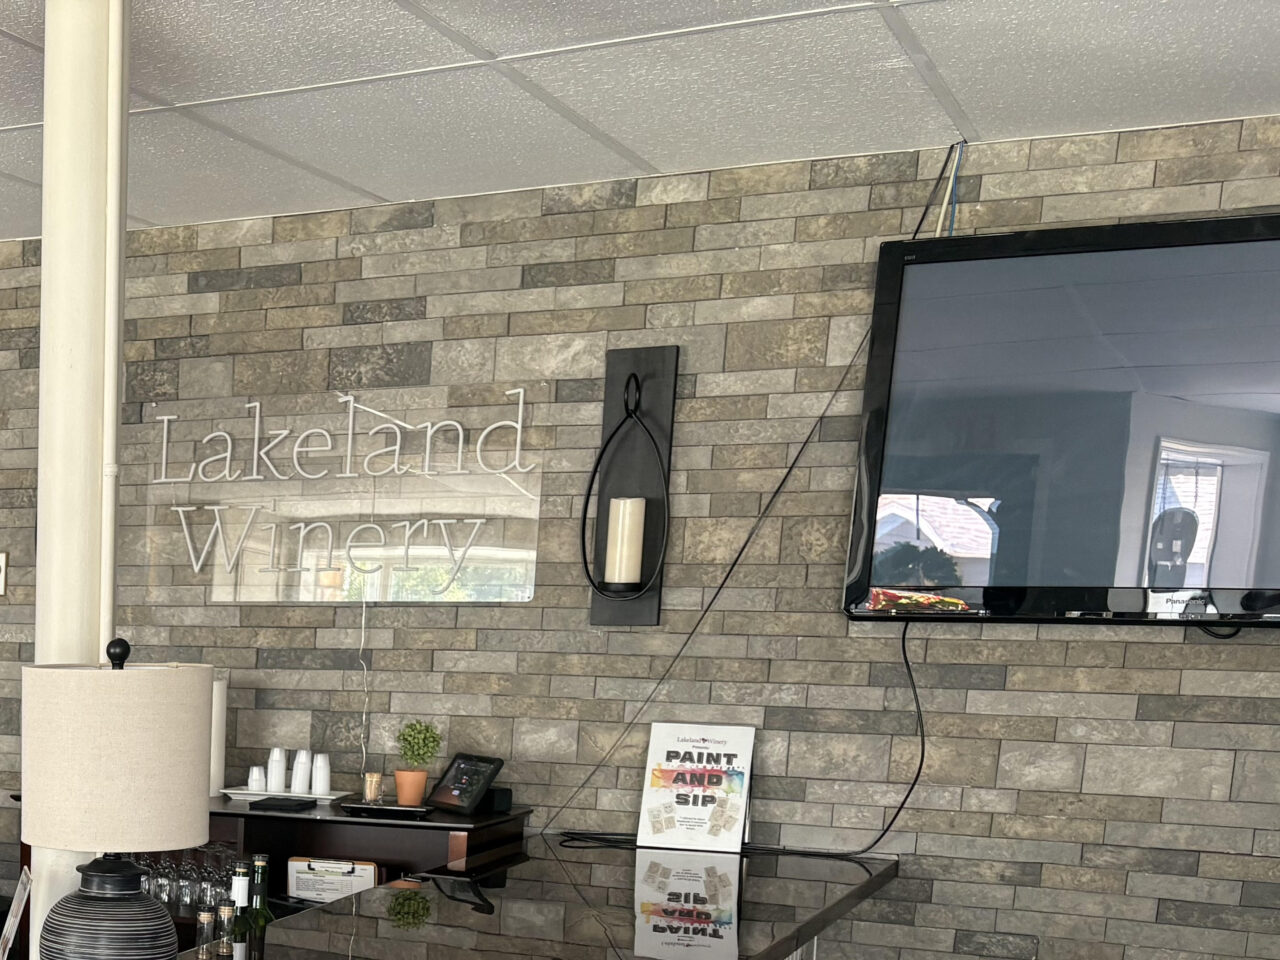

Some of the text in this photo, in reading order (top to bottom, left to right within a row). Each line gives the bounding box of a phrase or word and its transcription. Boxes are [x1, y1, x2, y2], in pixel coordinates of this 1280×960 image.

[152, 388, 536, 484] Lakeland
[170, 505, 487, 597] Winery
[665, 750, 738, 766] PAINT
[672, 772, 723, 786] AND
[674, 793, 717, 808] SIP
